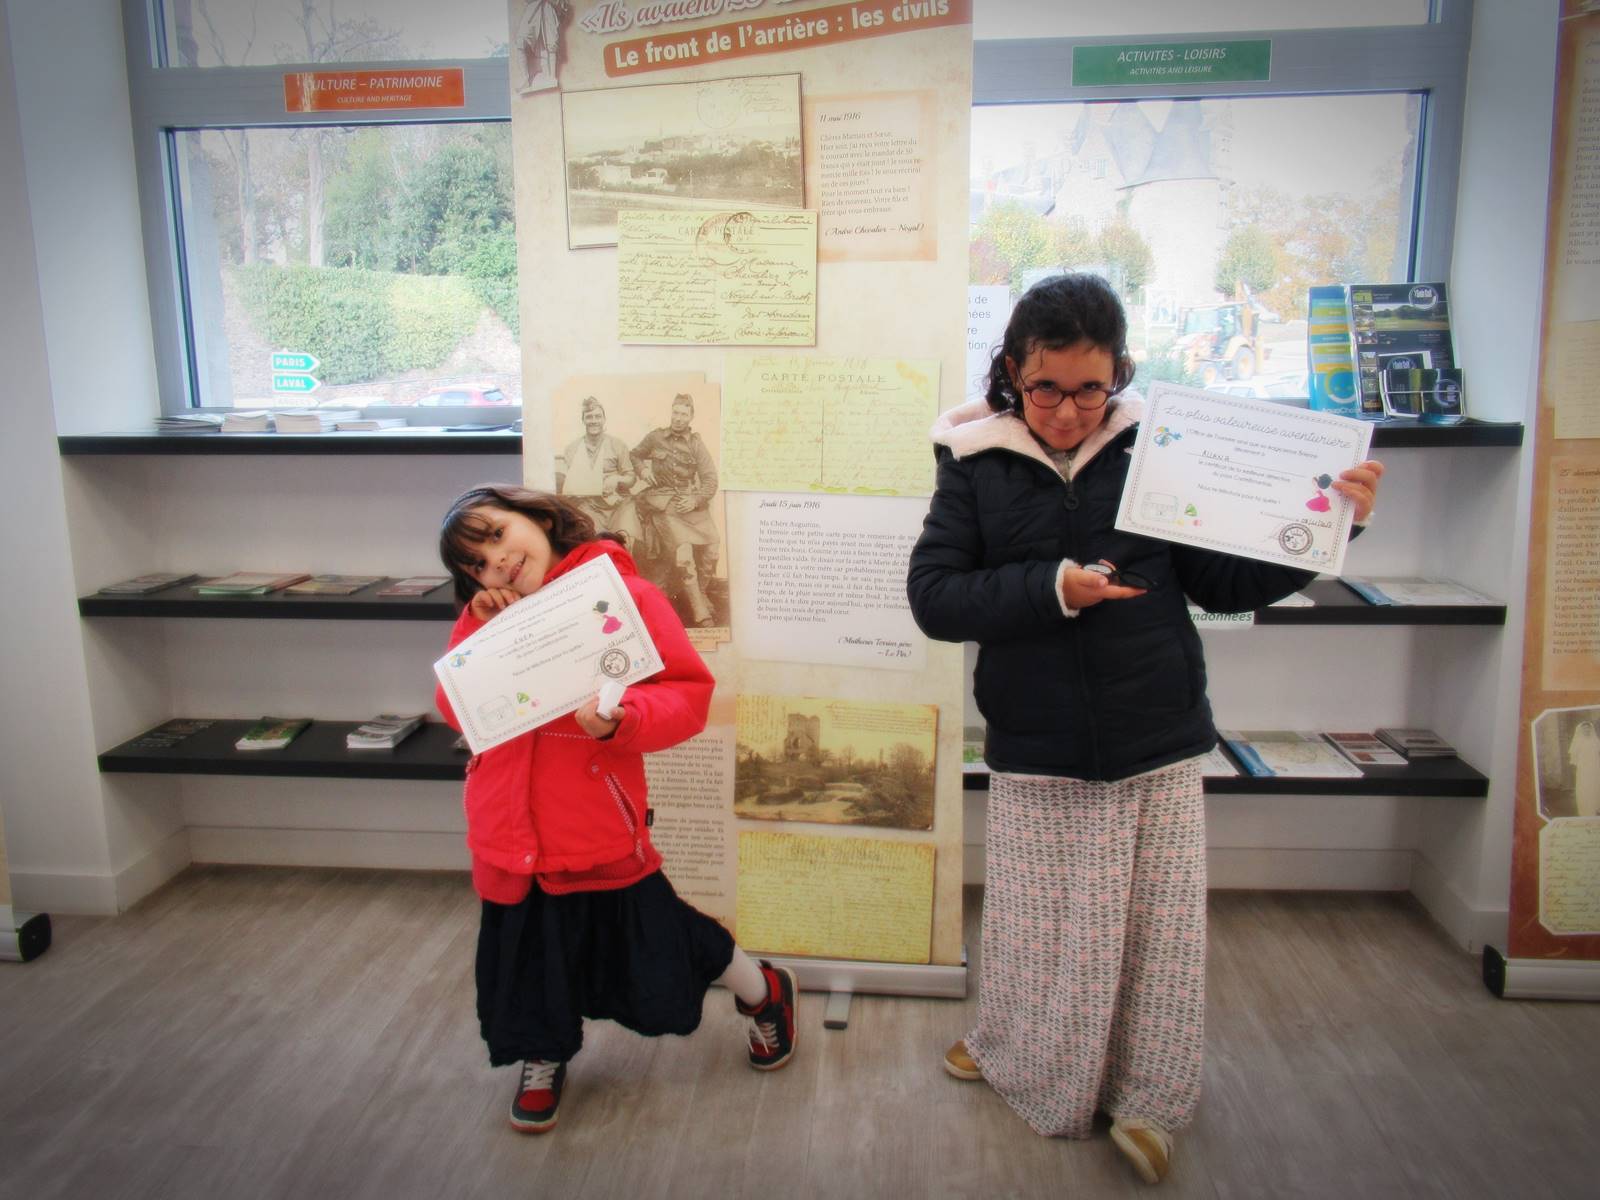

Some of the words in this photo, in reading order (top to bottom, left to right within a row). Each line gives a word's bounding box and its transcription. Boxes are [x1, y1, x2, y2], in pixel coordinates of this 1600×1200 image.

[615, 46, 639, 69] Le
[644, 37, 699, 63] front
[706, 31, 732, 54] de
[852, 7, 885, 29] les
[892, 0, 949, 23] civils
[1117, 50, 1174, 63] ACTIVITES
[1184, 48, 1226, 60] LOISIRS
[1129, 66, 1167, 76] ACTIVITIES
[1167, 66, 1183, 74] AND
[1184, 65, 1212, 74] LEISURE
[370, 76, 443, 89] PATRIMOINE
[336, 96, 364, 104] CULTURE
[366, 95, 380, 103] AND
[381, 94, 412, 103] HERITAGE
[843, 112, 862, 121] 1916
[974, 295, 988, 304] de
[276, 358, 304, 367] PARIS
[276, 376, 305, 387] LAVAL
[760, 373, 808, 383] CARTE
[818, 375, 888, 384] POSTALE
[803, 501, 821, 510] 1916
